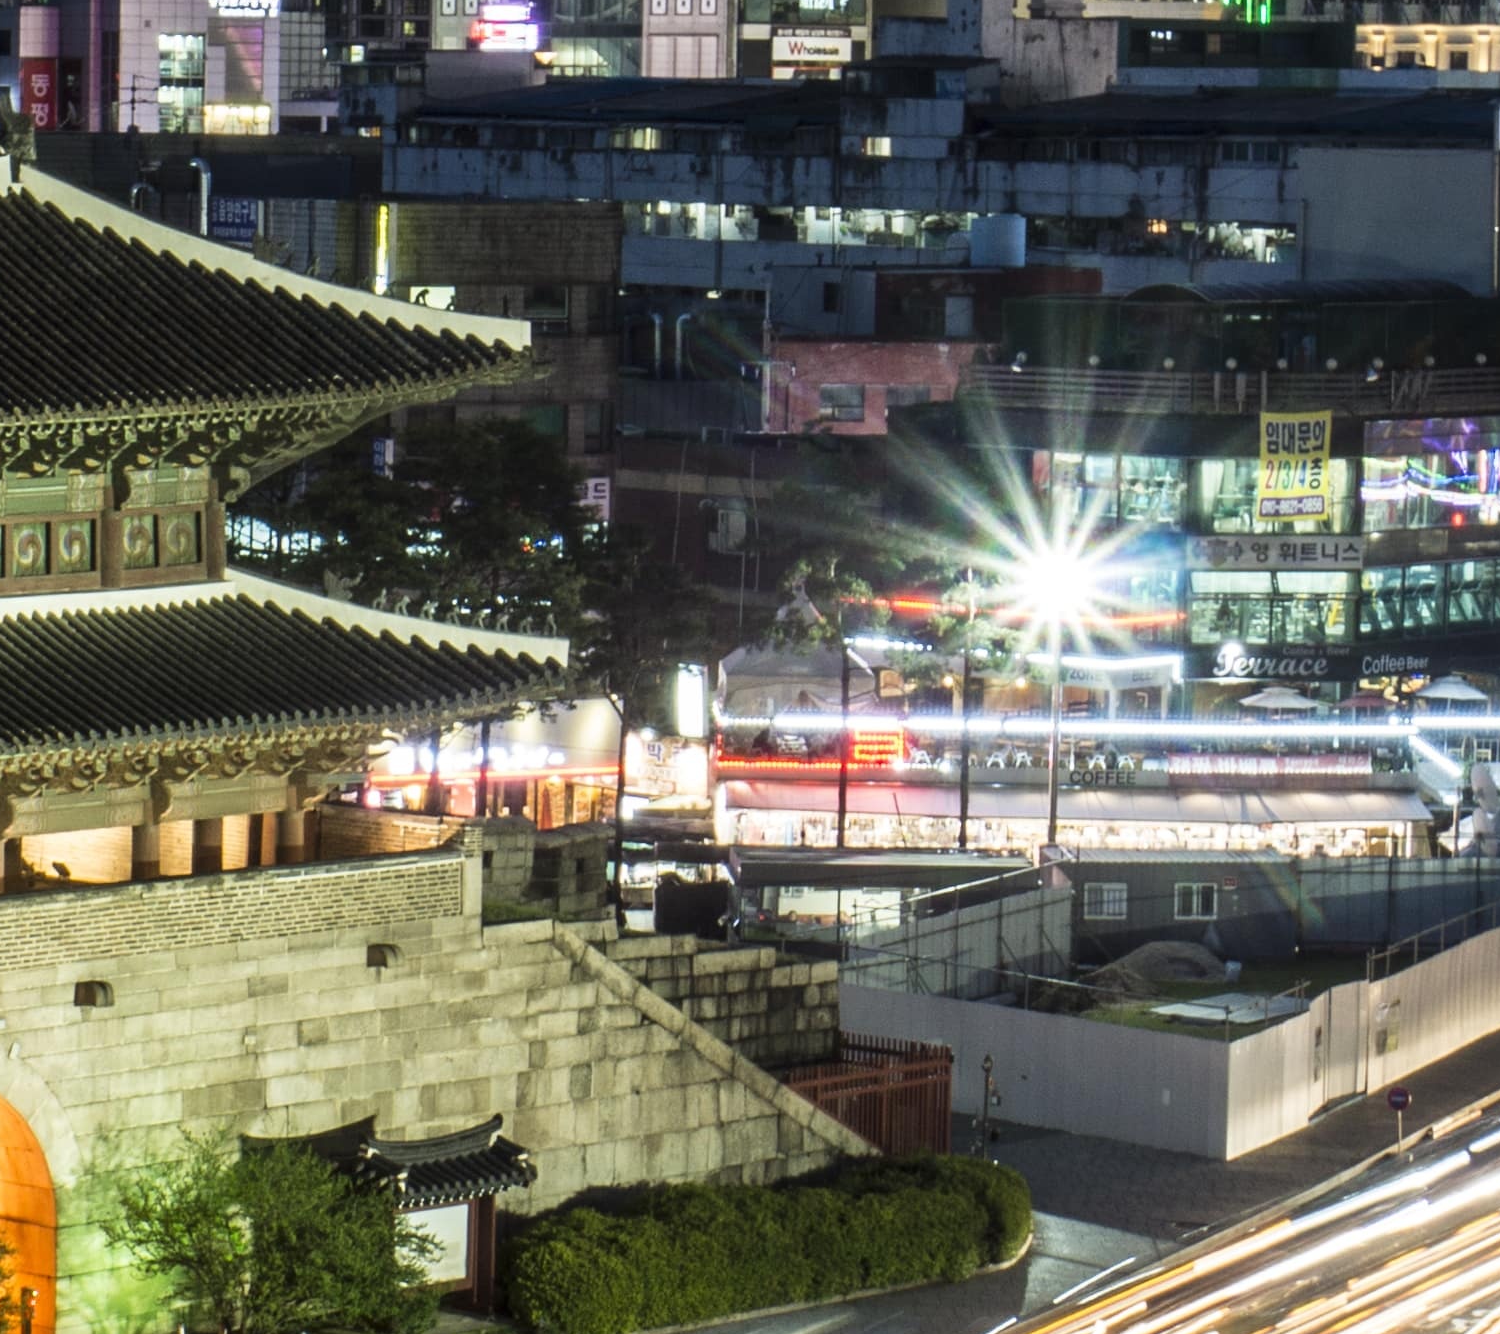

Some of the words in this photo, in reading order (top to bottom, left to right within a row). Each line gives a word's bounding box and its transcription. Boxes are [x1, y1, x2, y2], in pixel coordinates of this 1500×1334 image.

[1266, 420, 1326, 455] 임대문의
[1279, 541, 1361, 563] 휘트니스
[1362, 655, 1405, 676] Coffee
[1069, 770, 1137, 786] COFFEE
